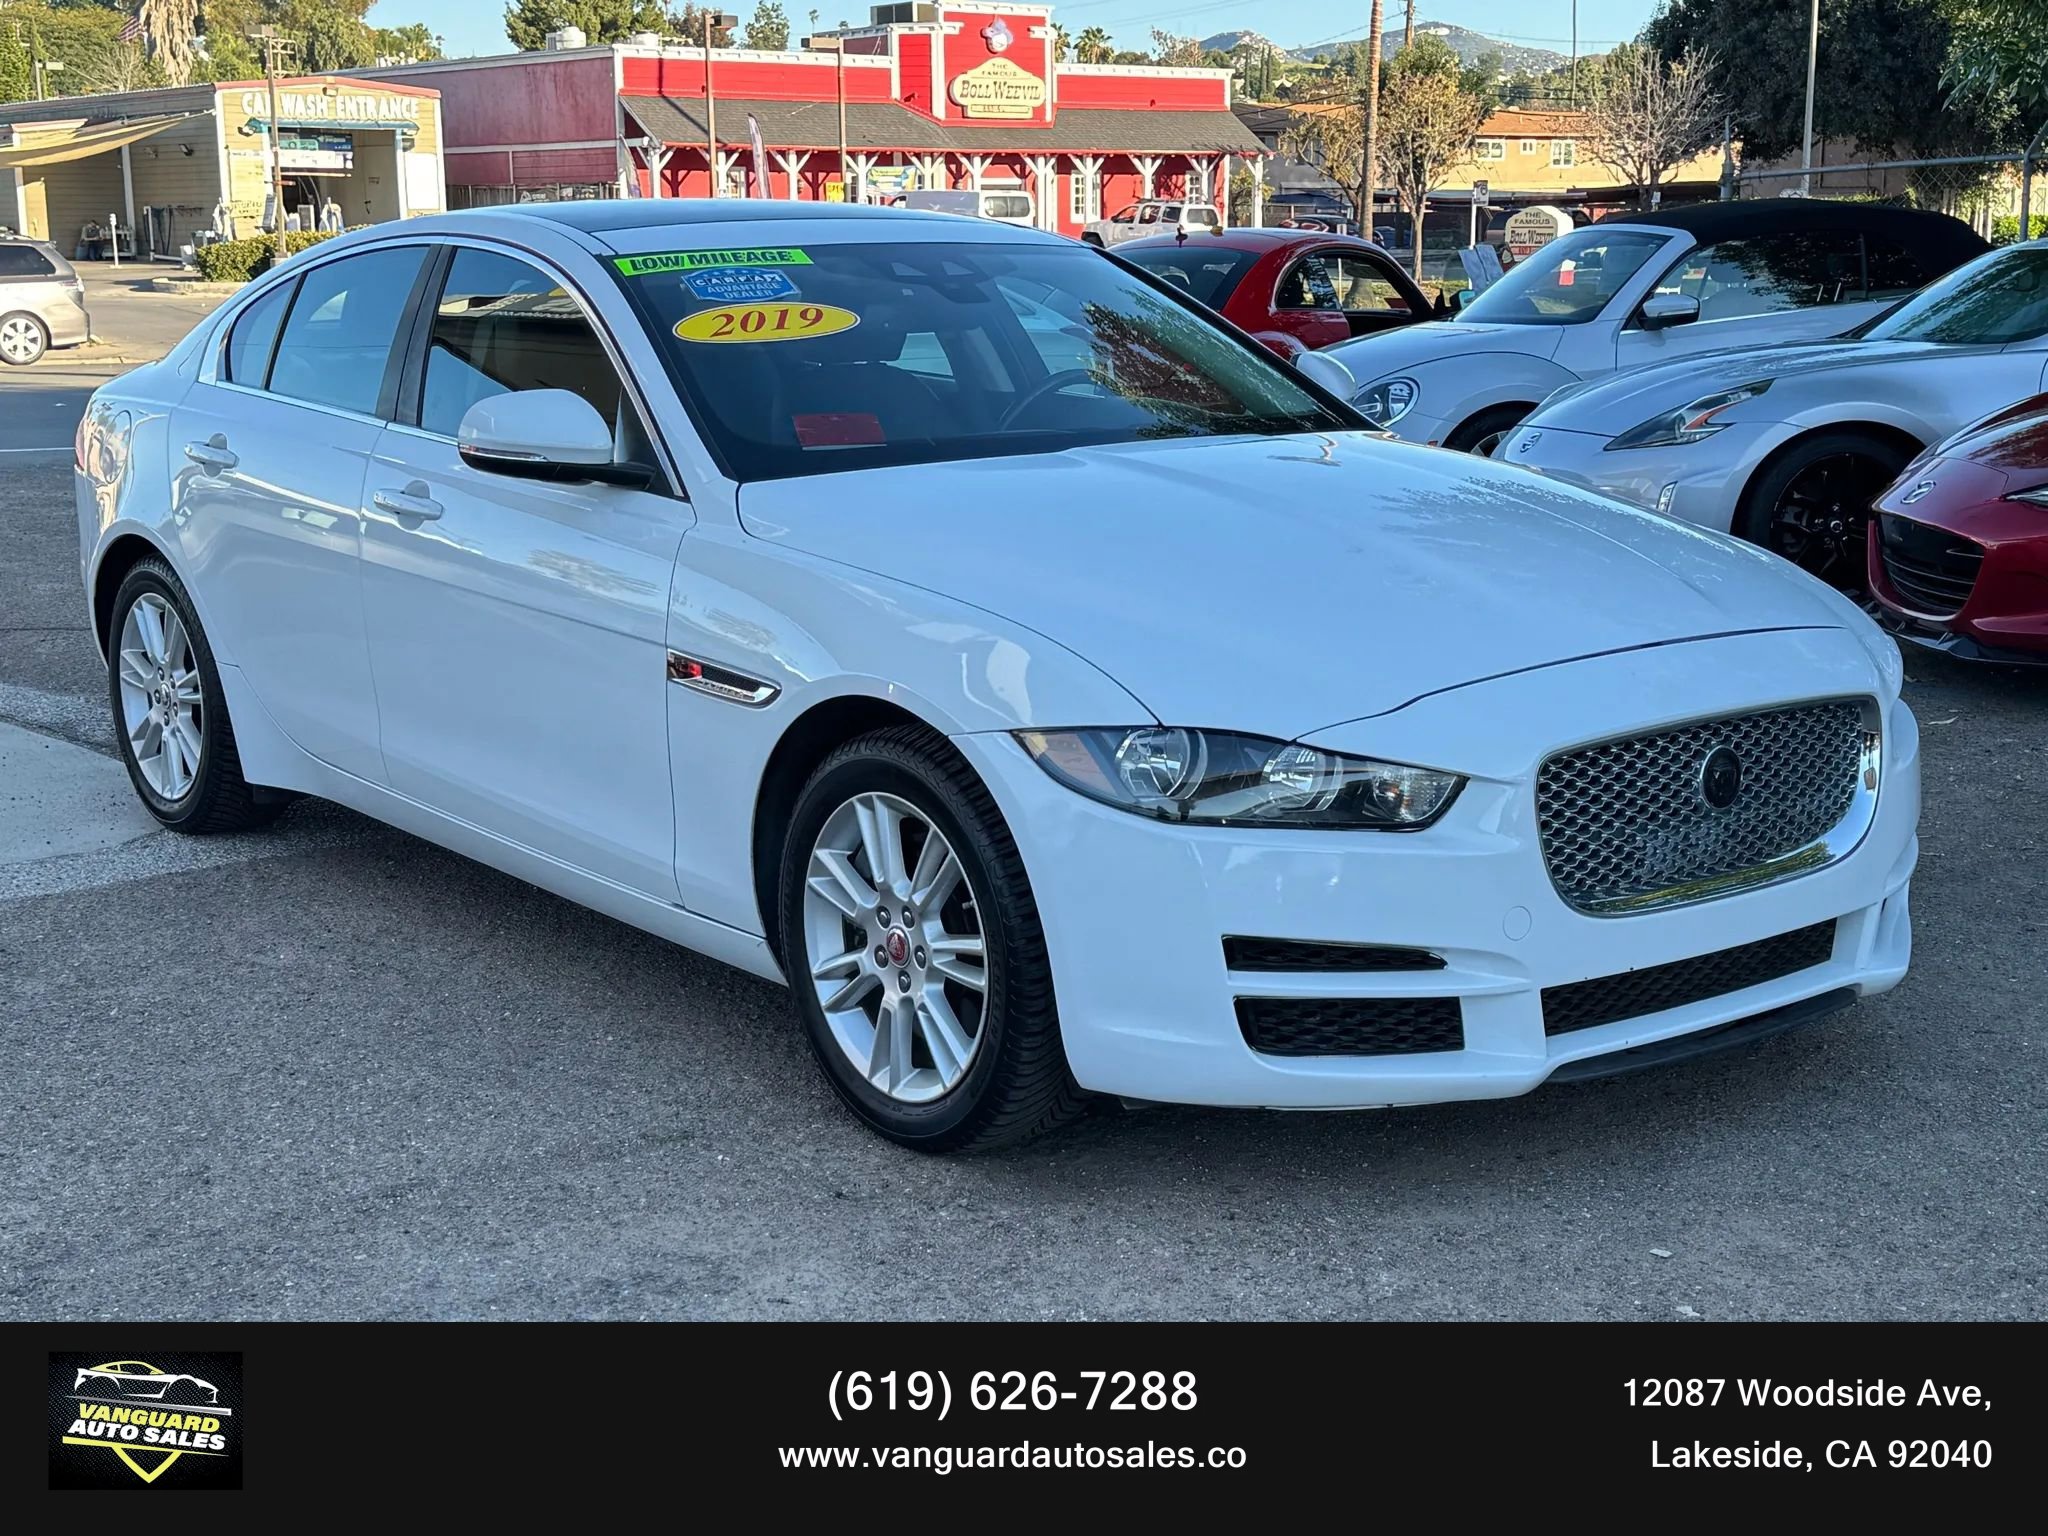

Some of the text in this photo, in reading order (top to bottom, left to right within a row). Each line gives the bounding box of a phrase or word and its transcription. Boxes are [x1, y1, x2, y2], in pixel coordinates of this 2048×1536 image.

[960, 80, 1041, 100] BOLL WEEVIL
[280, 94, 329, 117] WASH
[336, 96, 419, 119] ENTRANCE
[629, 250, 793, 272] LOW MILEAGE
[694, 273, 783, 287] CARFAX
[707, 281, 782, 294] ADVANTAGE
[723, 289, 775, 300] DEALER
[709, 307, 824, 338] 2019
